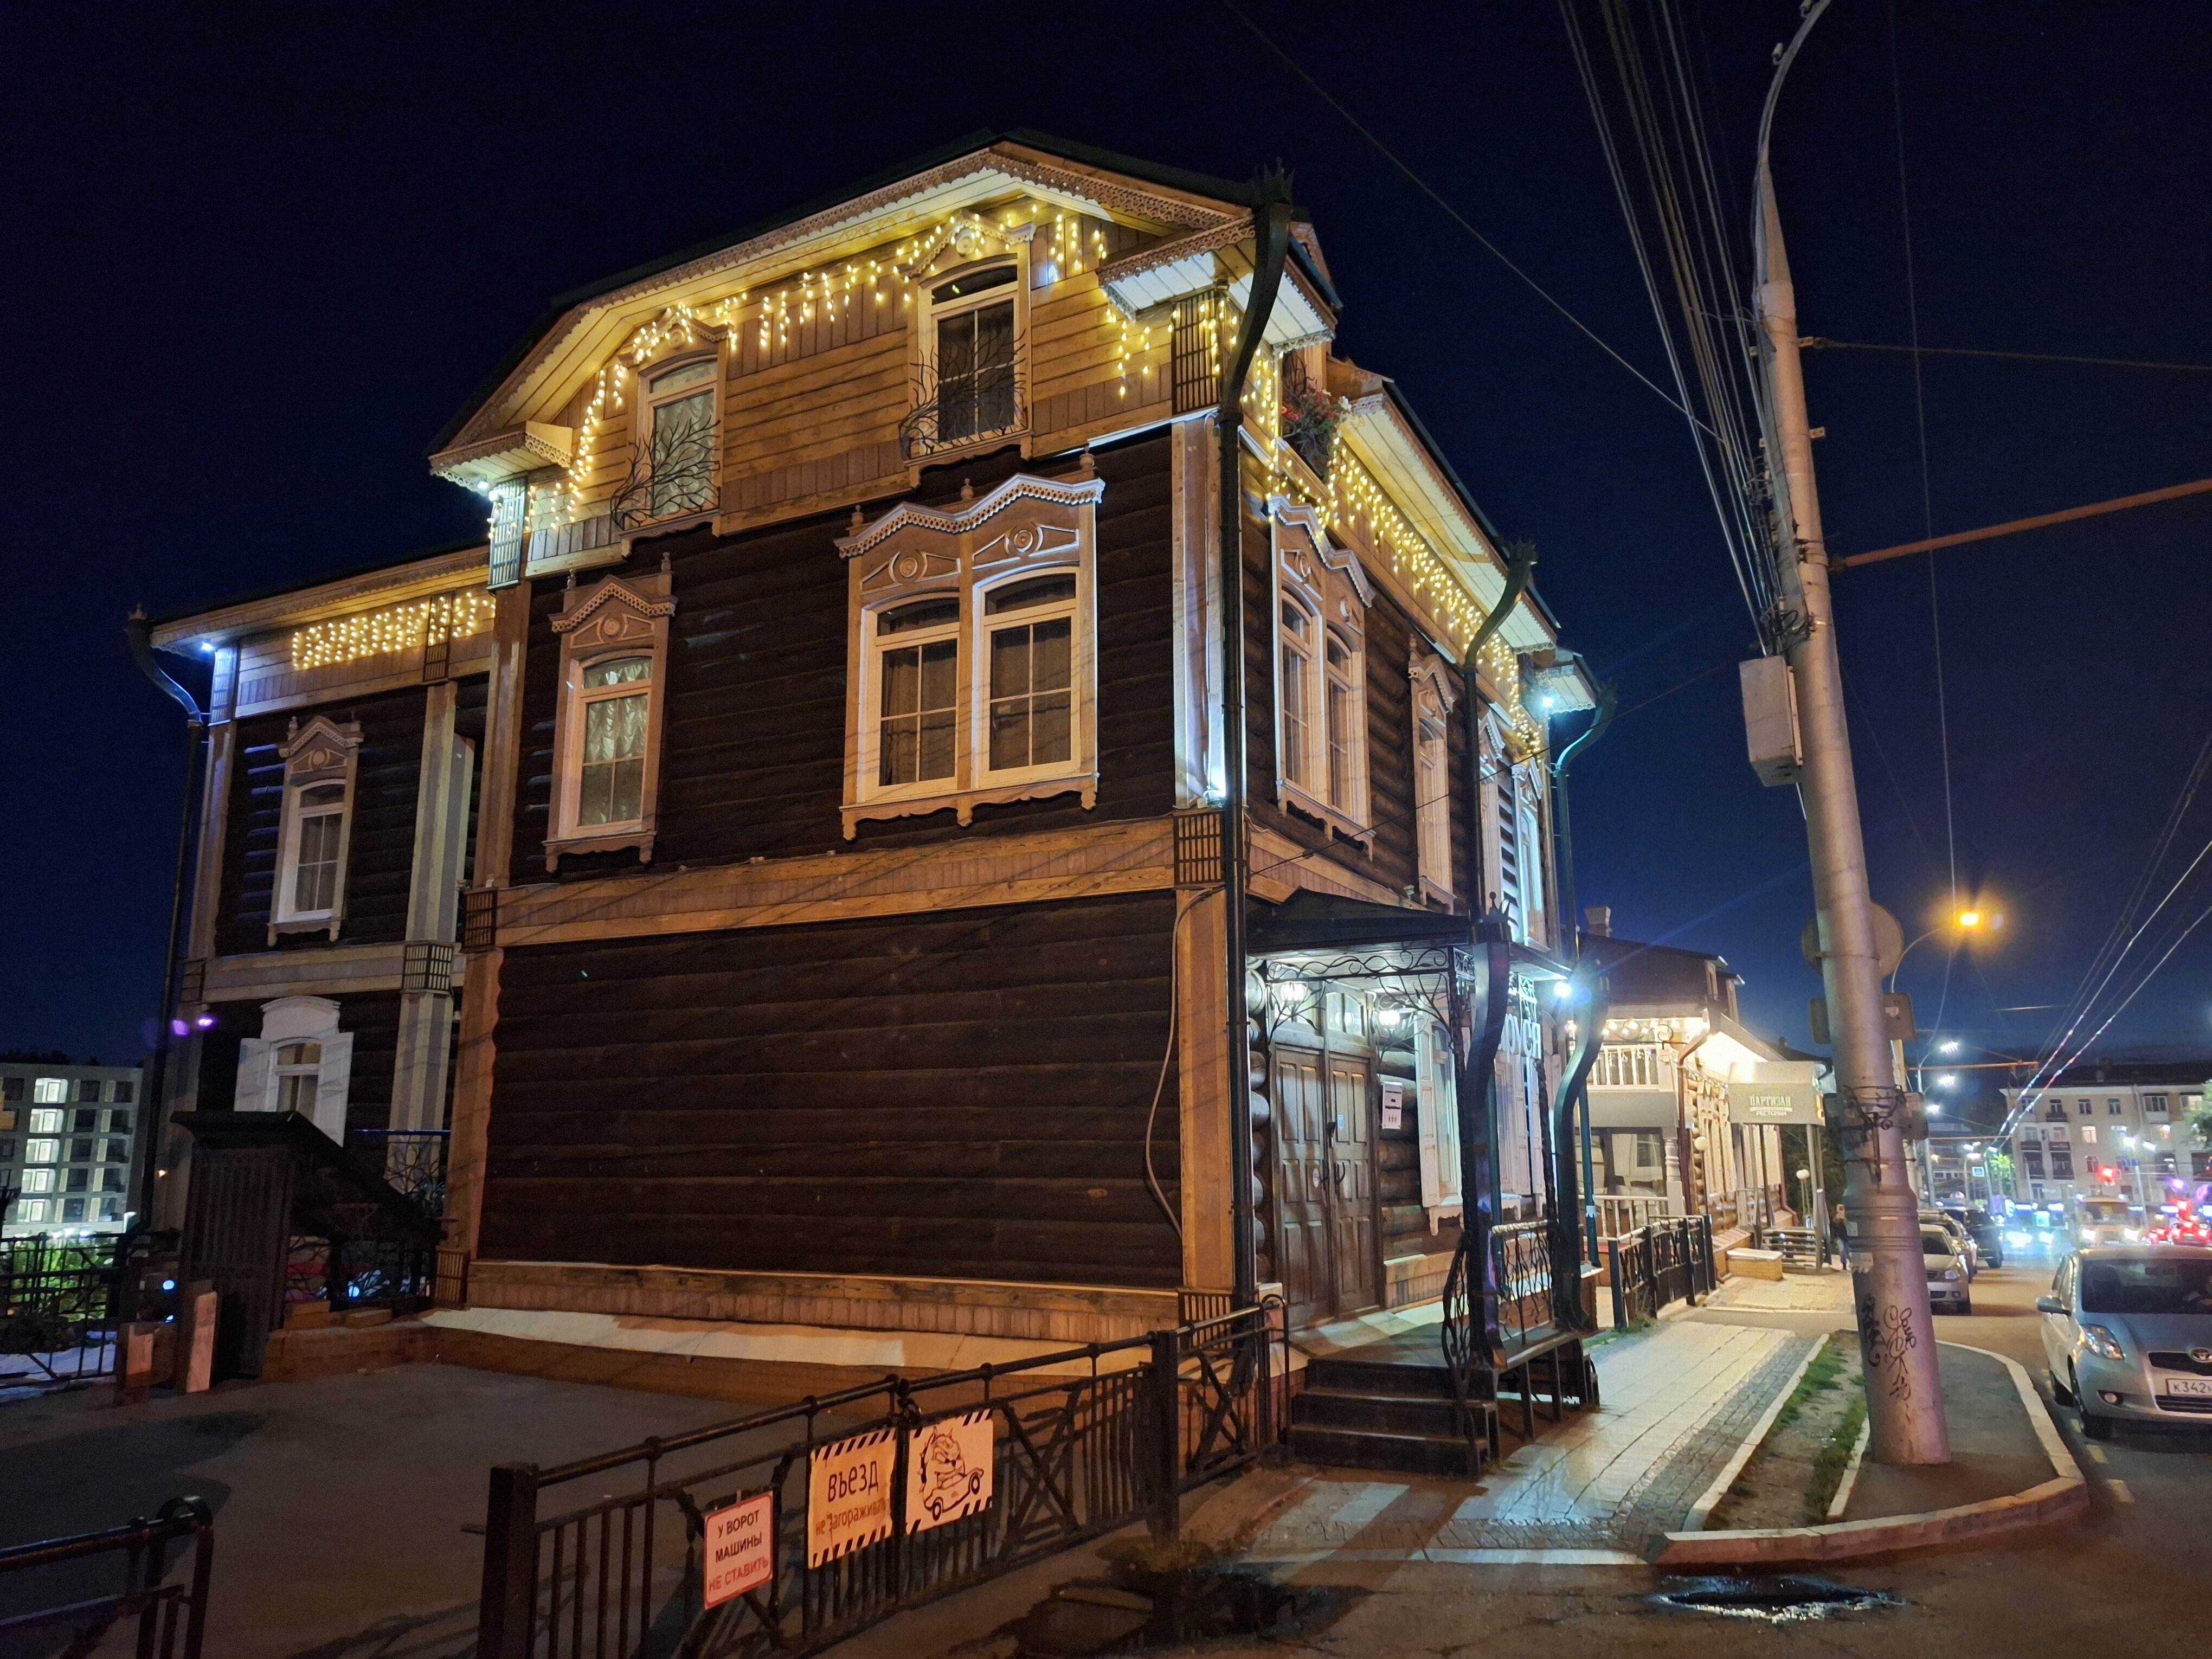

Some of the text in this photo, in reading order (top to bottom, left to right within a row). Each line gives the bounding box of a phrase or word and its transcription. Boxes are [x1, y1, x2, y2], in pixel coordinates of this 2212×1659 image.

[1749, 1095, 1791, 1107] ПАРТИЗАН
[717, 1509, 760, 1539] У ВОРОТ
[715, 1532, 762, 1562] МАШИНЫ
[709, 1555, 769, 1592] НЕ СТАВИТЬ
